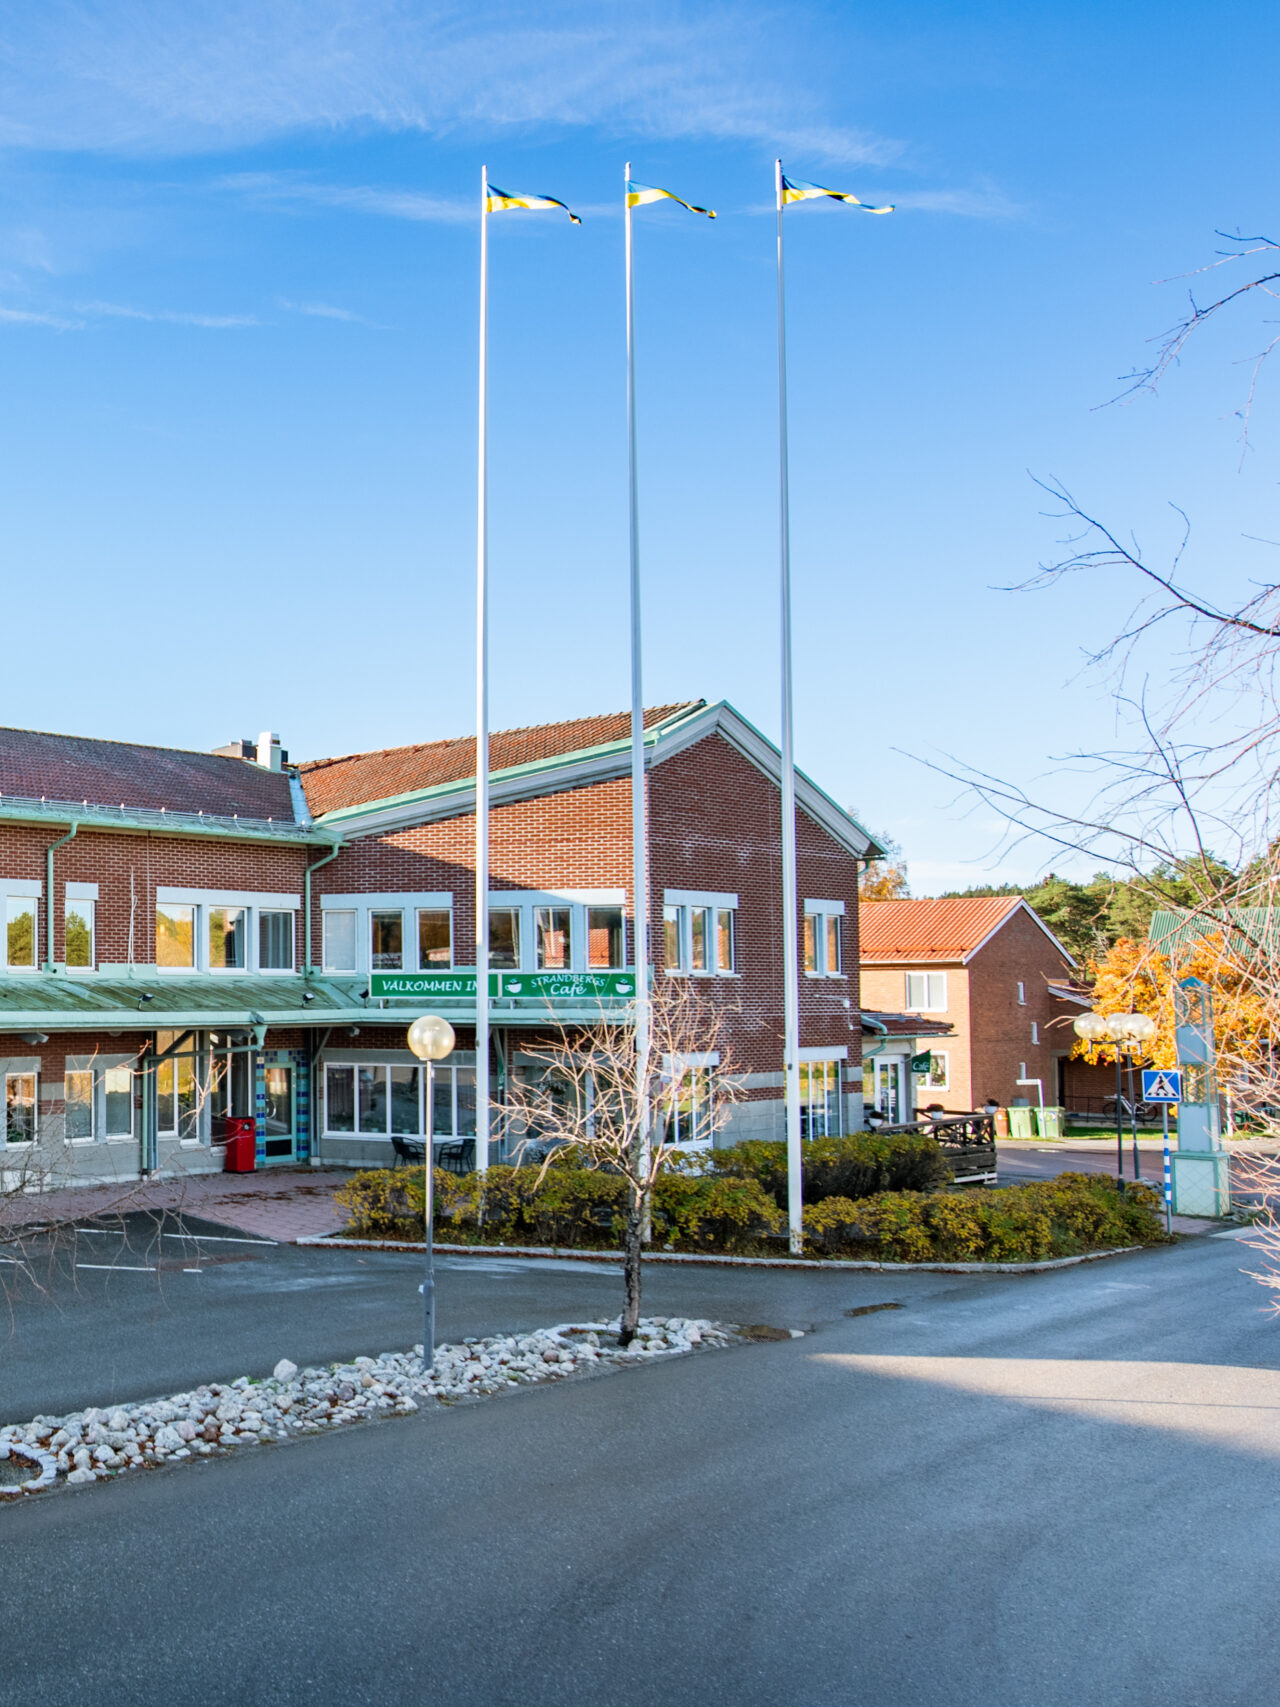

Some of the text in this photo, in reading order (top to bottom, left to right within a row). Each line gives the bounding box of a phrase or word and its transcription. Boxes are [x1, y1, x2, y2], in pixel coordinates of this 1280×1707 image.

[531, 974, 605, 987] STRANDBERGS
[550, 982, 587, 997] Café
[913, 1061, 930, 1071] Café
